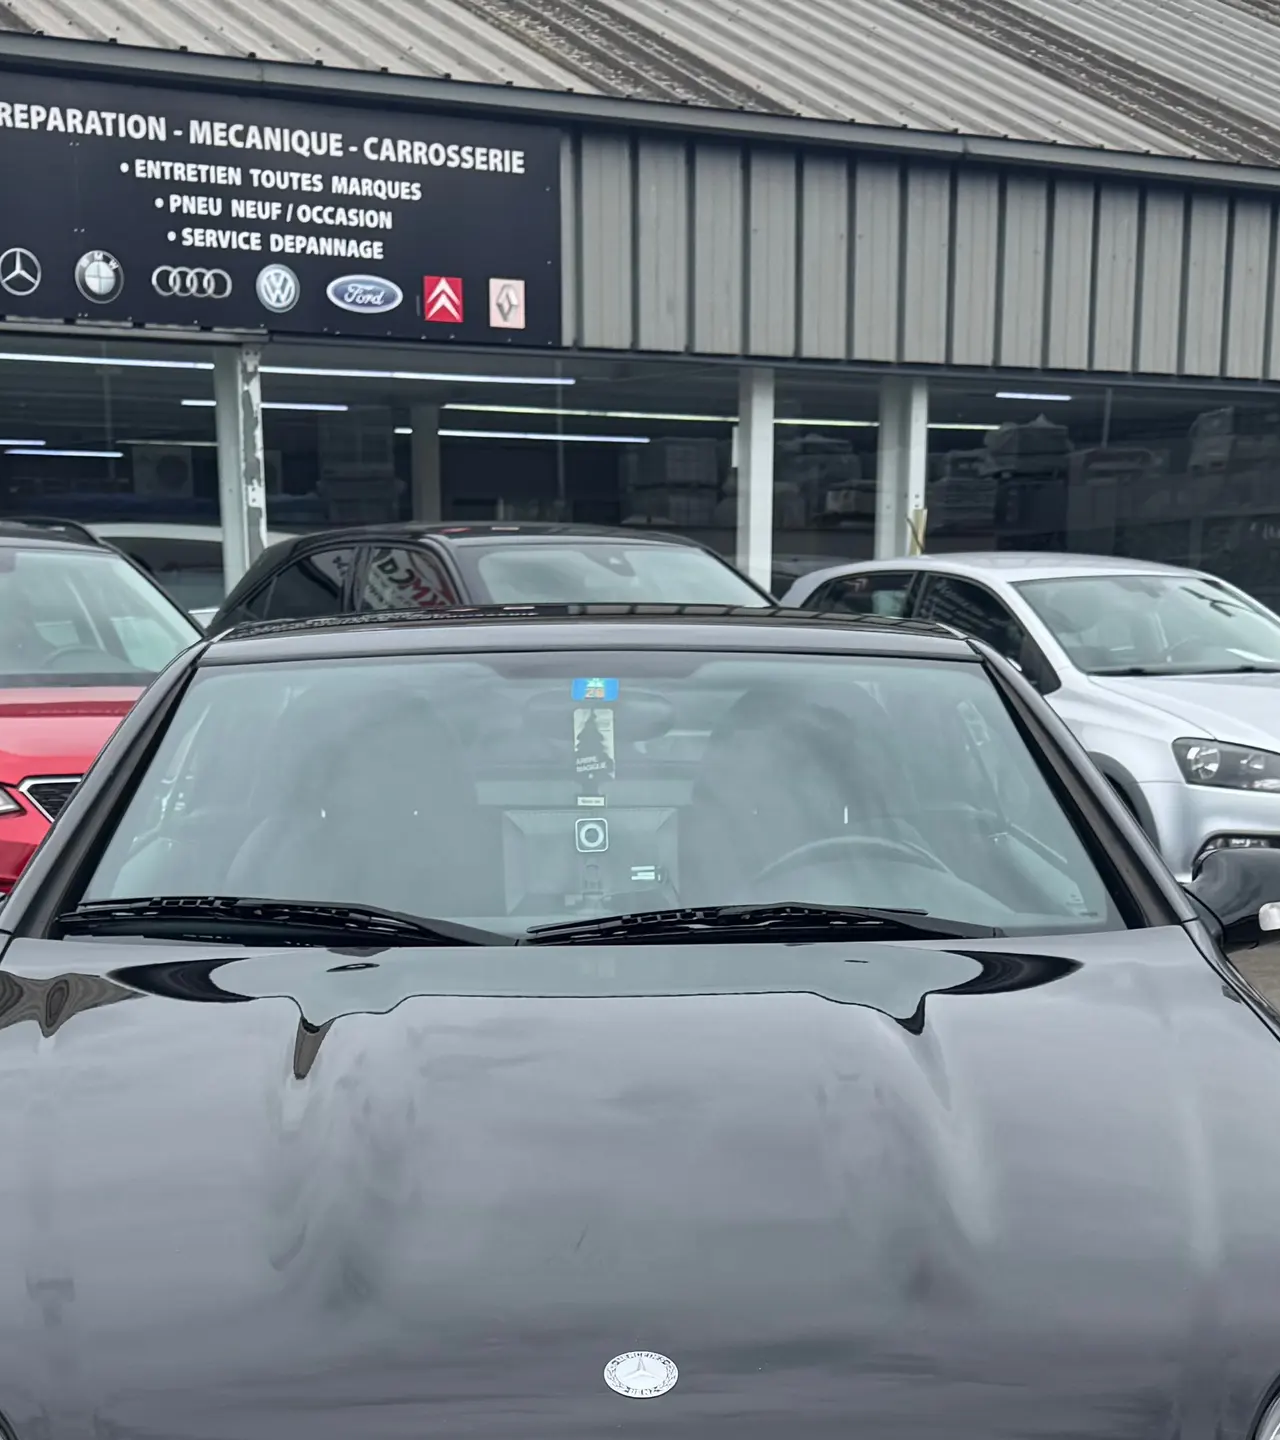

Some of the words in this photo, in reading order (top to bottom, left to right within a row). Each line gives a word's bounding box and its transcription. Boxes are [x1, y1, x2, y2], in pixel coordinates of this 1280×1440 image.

[189, 120, 343, 158] MECANIQUE
[363, 137, 525, 174] CARROSSERIE
[135, 159, 242, 186] ENTRETIEN
[250, 168, 323, 193] TOUTES
[332, 176, 422, 201] MARQUES
[170, 195, 223, 217] PNEU
[231, 200, 282, 222] NEUF
[297, 205, 392, 230] OCCASION
[182, 228, 262, 251] SERVICE
[270, 234, 383, 260] DEPANNAGE
[344, 283, 384, 305] Ford
